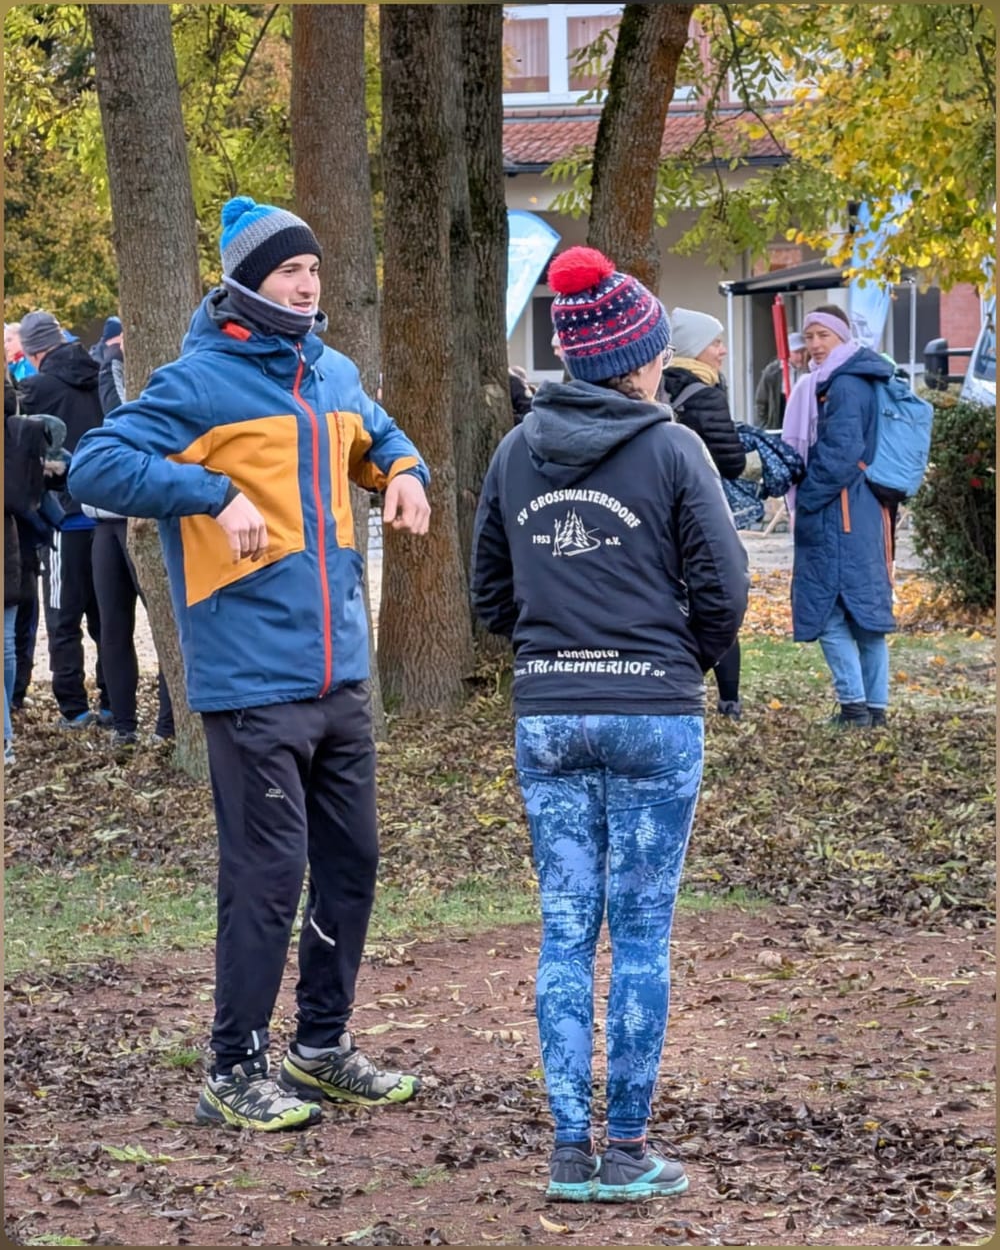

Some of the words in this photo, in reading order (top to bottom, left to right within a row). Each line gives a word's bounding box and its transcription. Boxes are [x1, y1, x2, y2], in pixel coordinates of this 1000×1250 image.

[516, 508, 529, 526] SV
[529, 488, 642, 529] GROSSWALTERSDORF
[532, 535, 551, 545] 1953
[605, 536, 621, 546] e.V.
